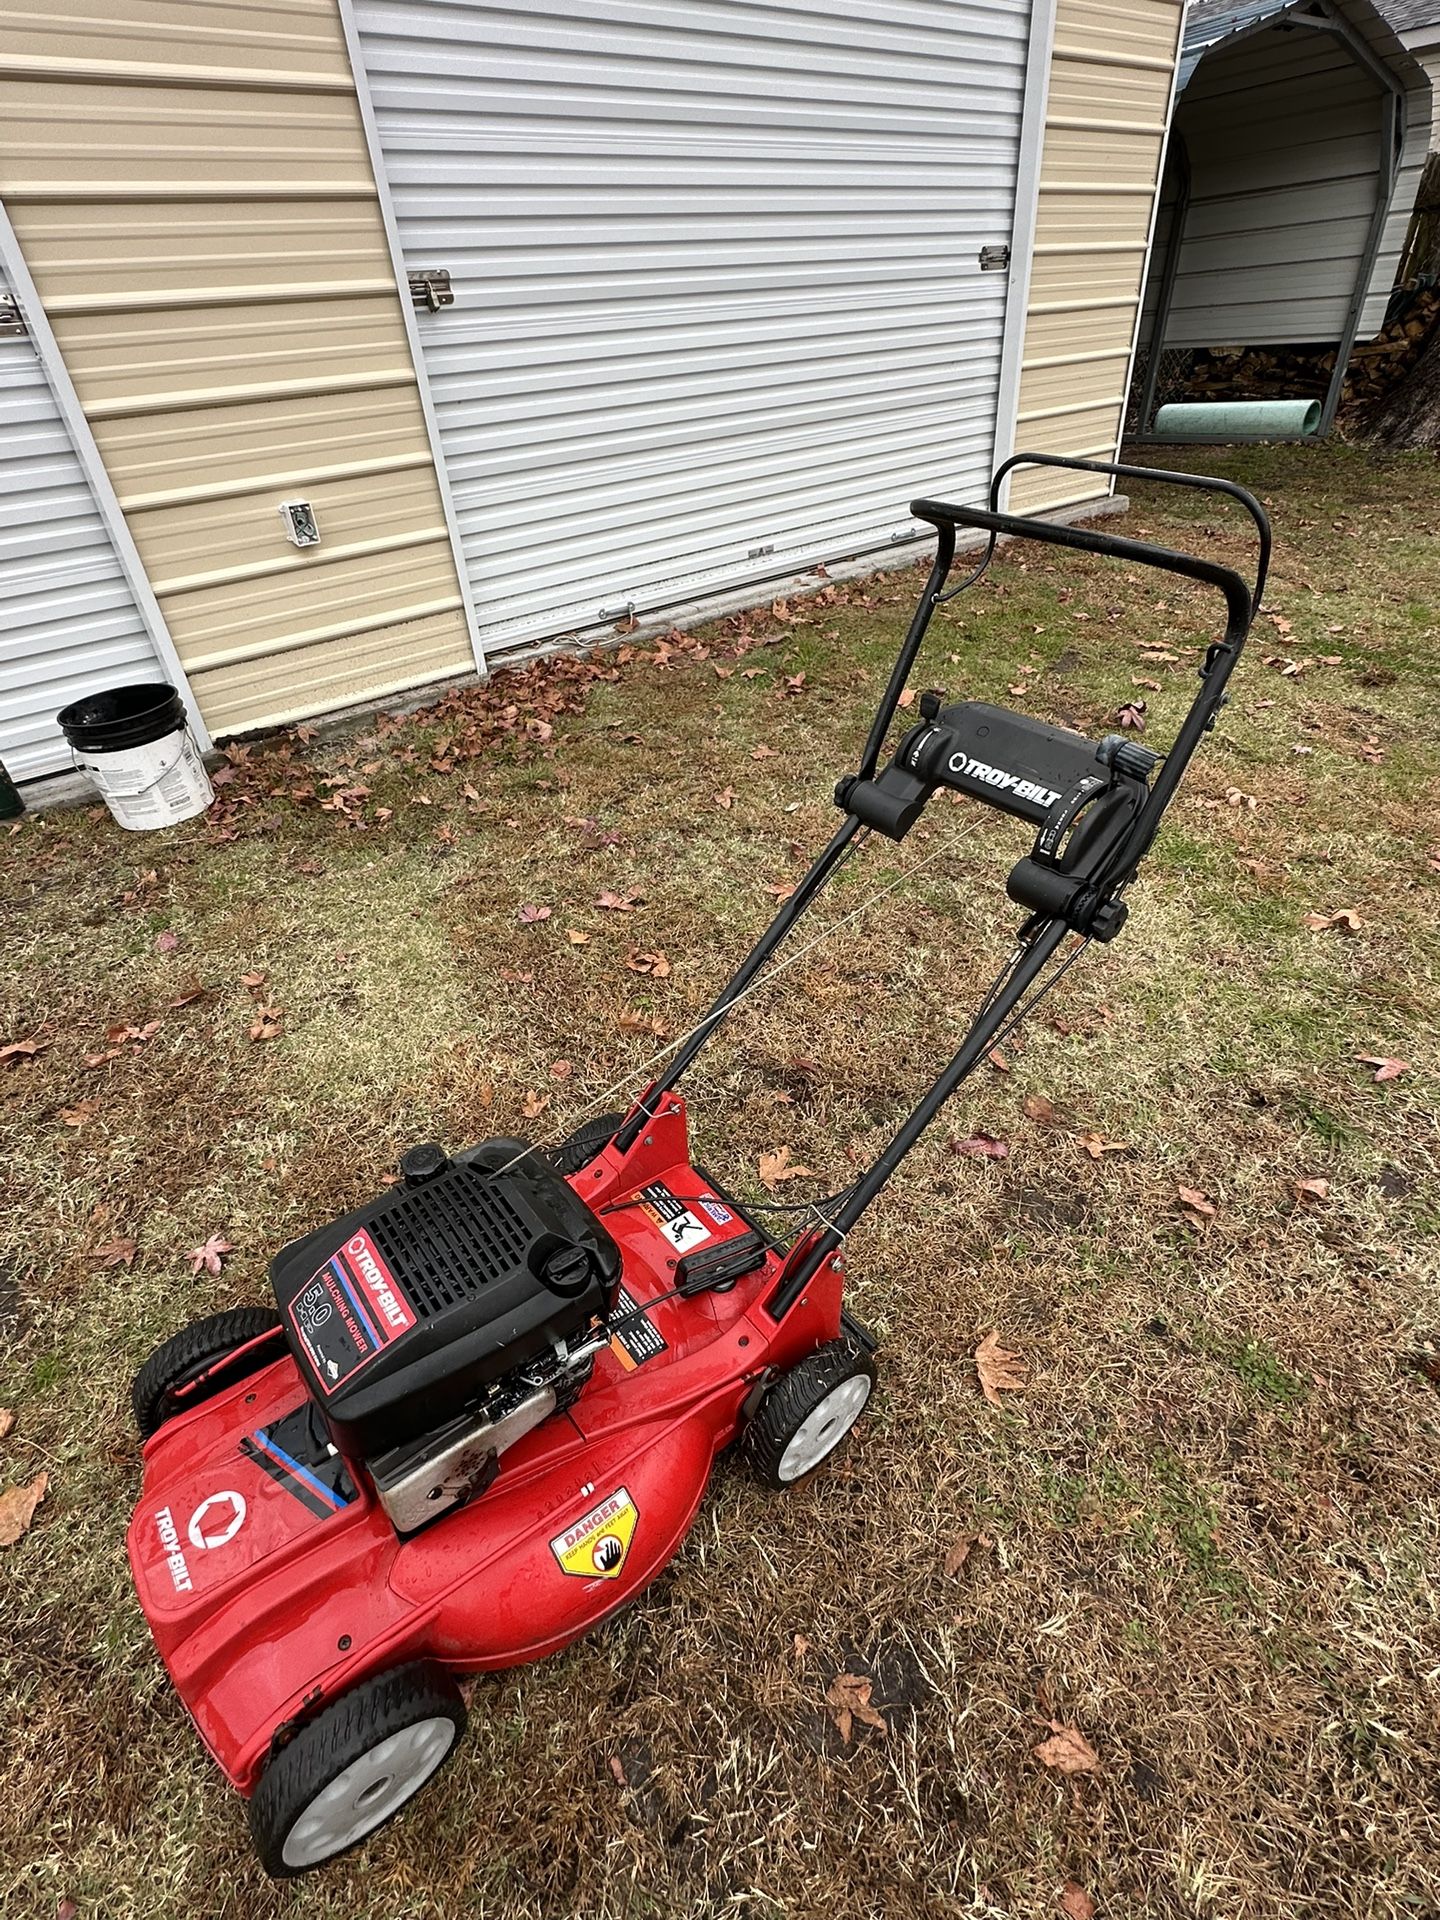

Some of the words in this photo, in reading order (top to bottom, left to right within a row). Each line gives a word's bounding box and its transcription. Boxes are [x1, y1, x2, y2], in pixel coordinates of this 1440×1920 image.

[964, 759, 1061, 807] TROY-BILT
[634, 1194, 657, 1218] WARG
[303, 1283, 332, 1326] 5.0
[355, 1249, 408, 1327] TROY-BILT
[322, 1272, 349, 1318] MULCHING
[345, 1317, 368, 1353] MOWER
[564, 1500, 619, 1548] DANGER
[566, 1548, 578, 1560] KEEP
[579, 1535, 595, 1550] HANDS
[605, 1519, 616, 1530] FEET
[155, 1506, 193, 1592] TROY-BILT
